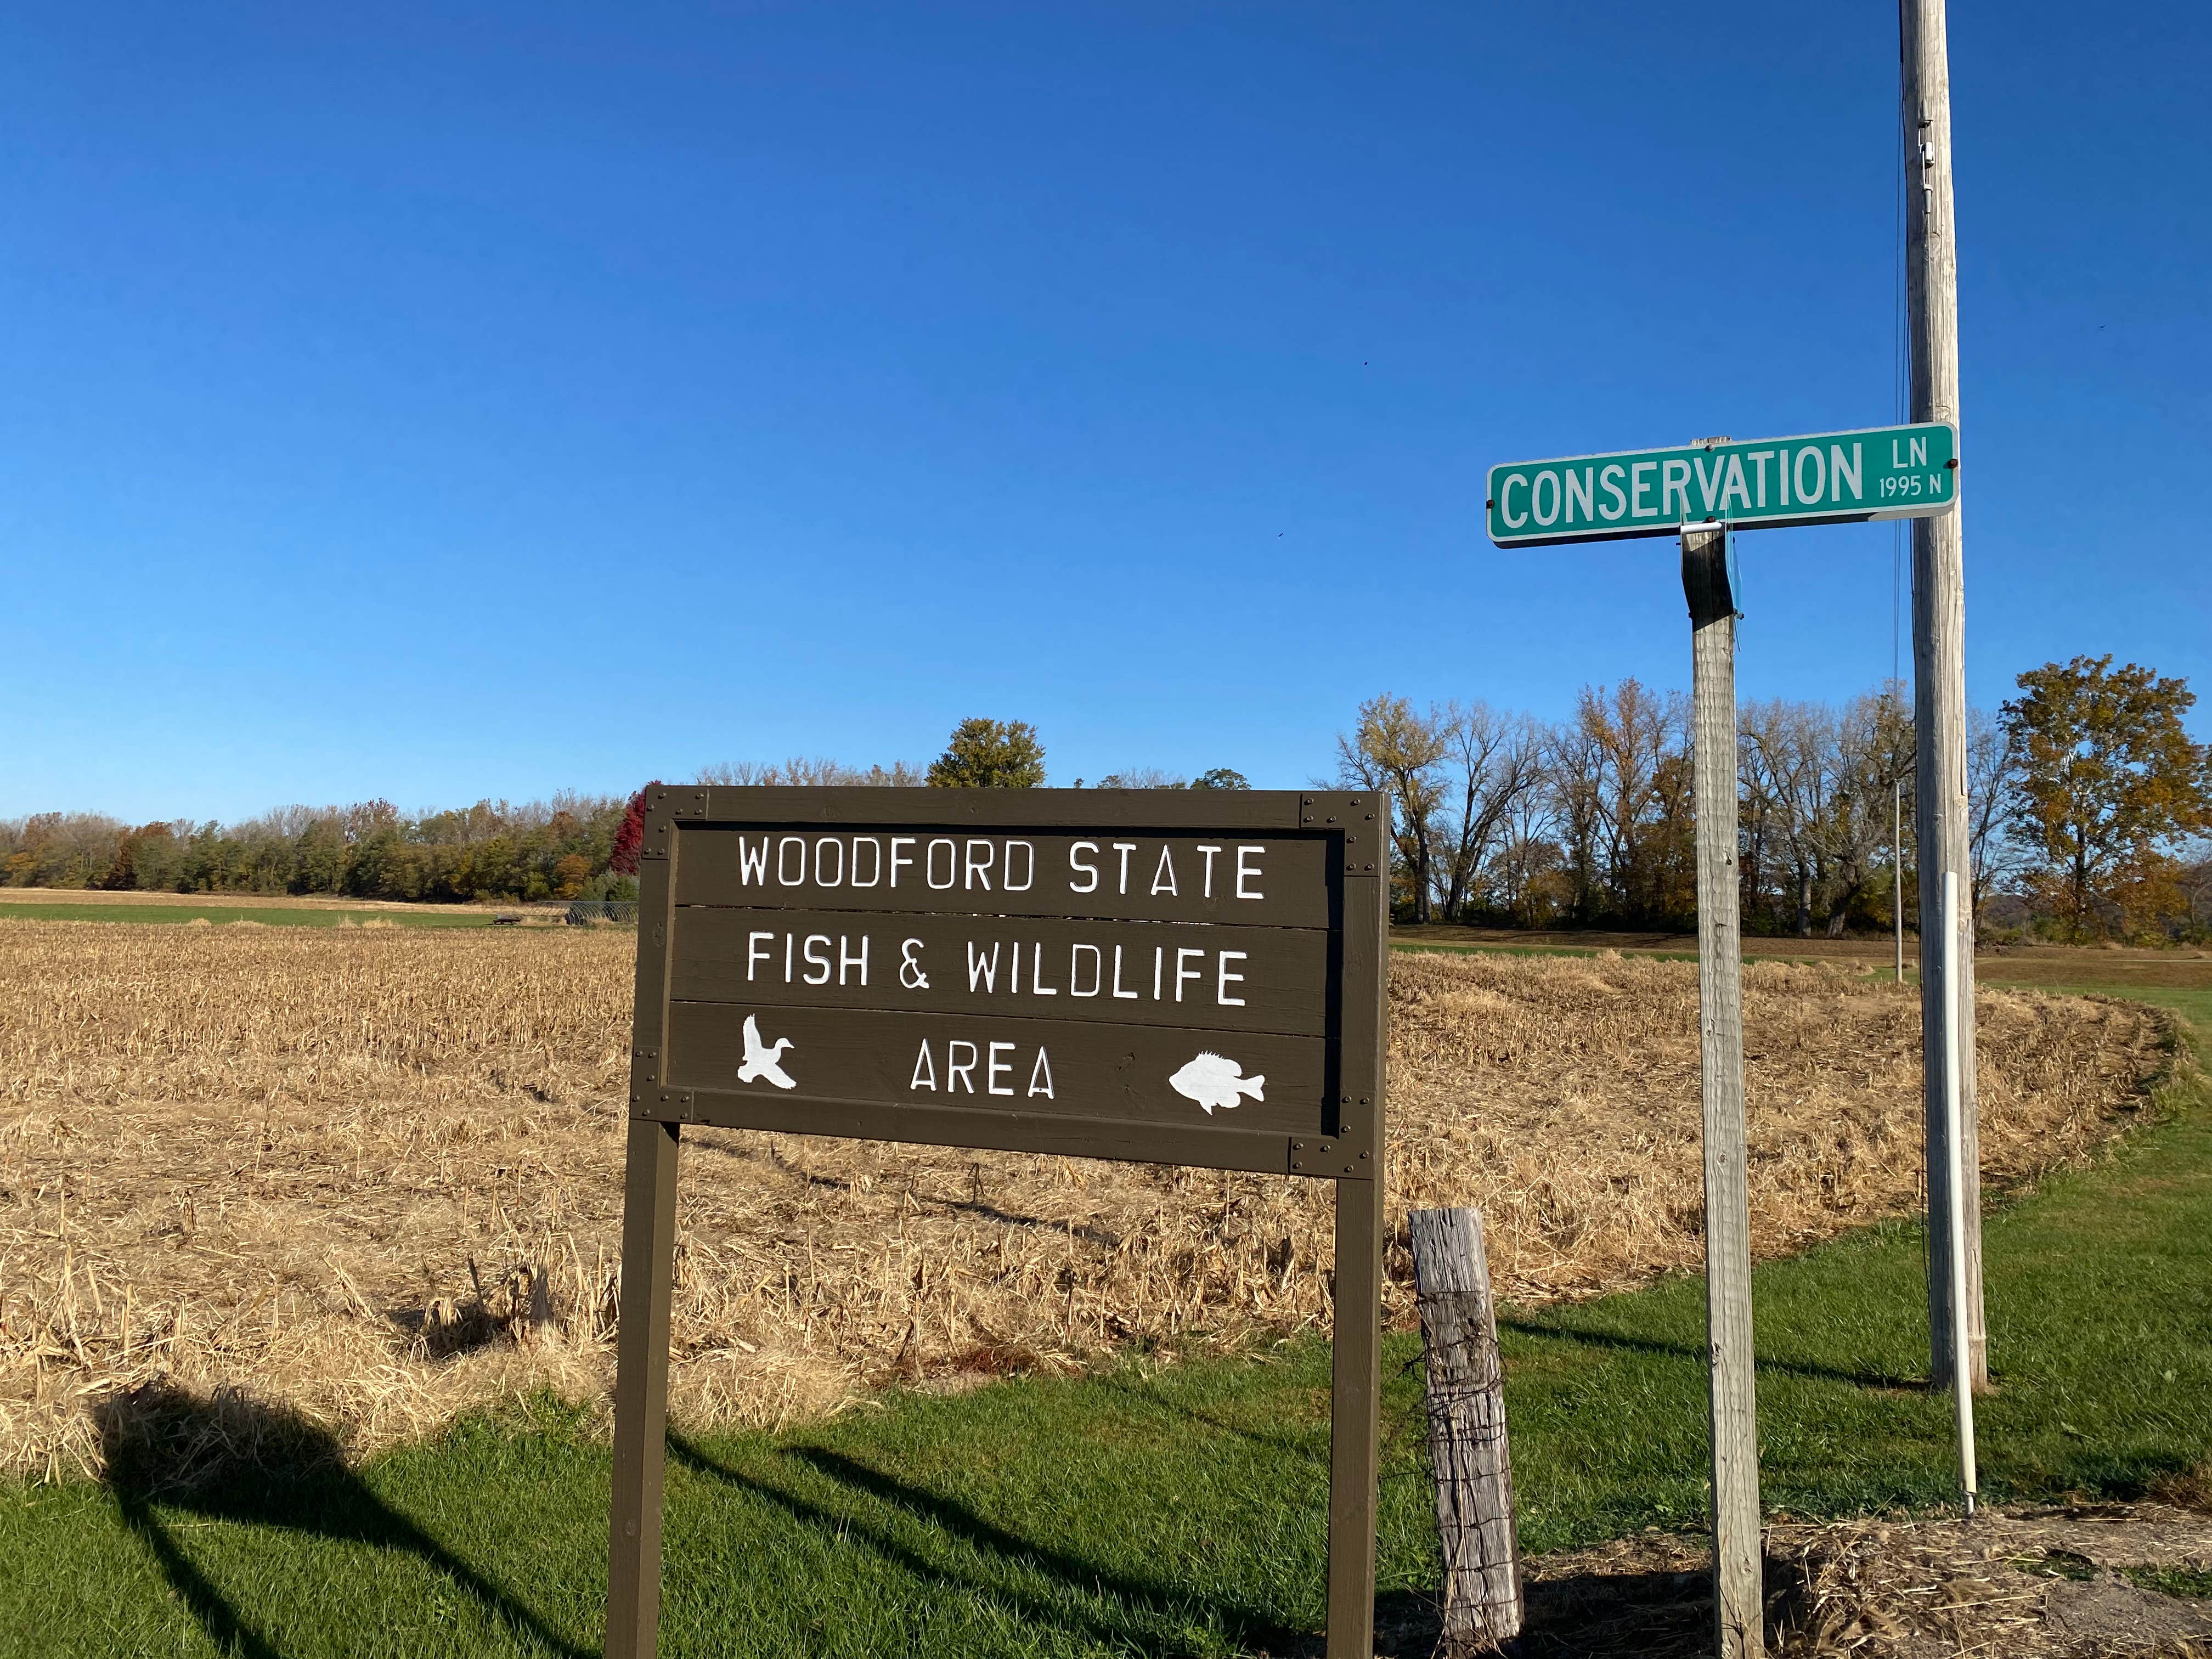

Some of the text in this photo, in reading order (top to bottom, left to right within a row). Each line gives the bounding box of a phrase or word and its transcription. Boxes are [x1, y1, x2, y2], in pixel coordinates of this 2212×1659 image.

[1501, 437, 1927, 529] CONSERVATION LN
[1880, 474, 1942, 498] 1995 N
[740, 837, 1265, 899] WOODFORD STATE
[748, 932, 1247, 1006] FISH & WILDLIFE
[911, 1039, 1053, 1099] AREA
